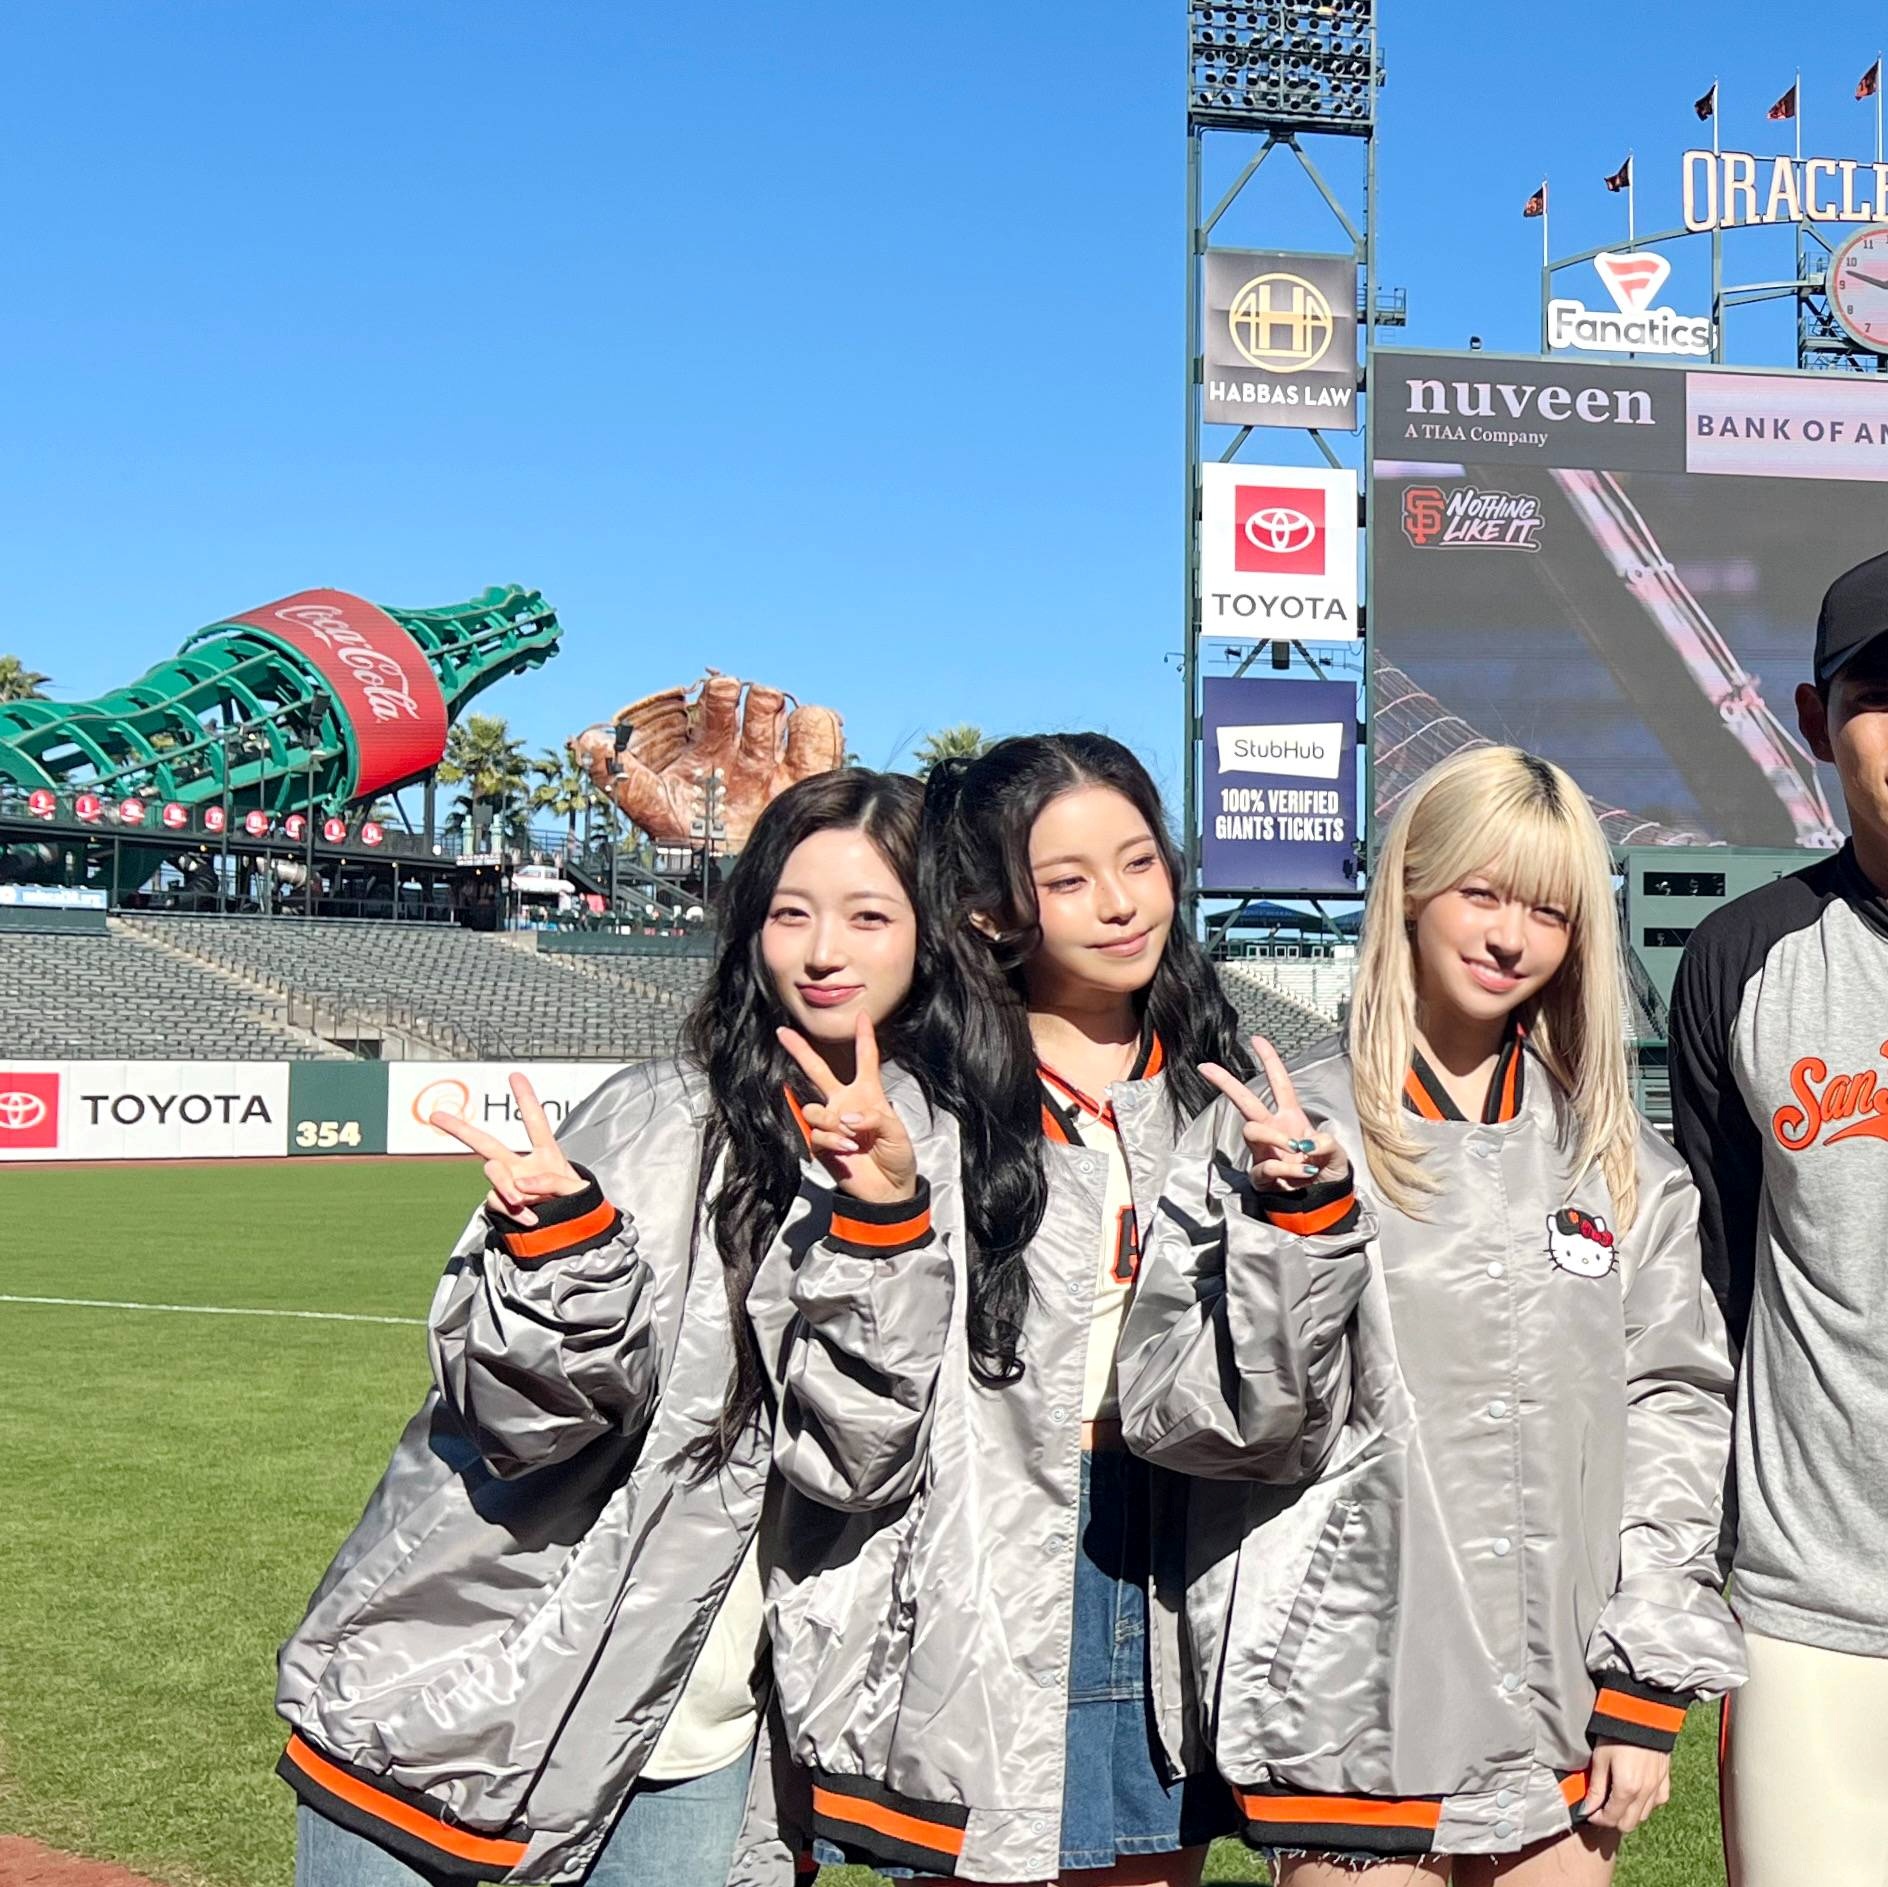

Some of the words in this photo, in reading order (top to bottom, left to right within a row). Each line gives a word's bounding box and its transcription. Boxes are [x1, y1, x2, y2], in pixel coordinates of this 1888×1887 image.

[1556, 308, 1708, 348] Fanatics
[1209, 381, 1299, 405] HABBAS
[1304, 386, 1352, 407] LAW
[1406, 378, 1656, 425] nuveen
[1404, 424, 1419, 438] A
[1422, 424, 1466, 441] TIAA
[1470, 426, 1549, 447] Company
[1697, 414, 1791, 440] BANK
[1803, 419, 1844, 443] OF
[1443, 515, 1506, 542] LIKE
[1505, 518, 1541, 544] IT
[1212, 593, 1348, 621] TOYOTA
[1234, 739, 1325, 760] StubHub
[1221, 788, 1265, 813] 100%
[1267, 789, 1339, 814] VERIFIED
[1216, 816, 1275, 840] GIANTS
[1277, 817, 1345, 841] TICKETS
[81, 1093, 273, 1126] TOYOTA
[1772, 1056, 1877, 1151] San
[295, 1121, 361, 1148] 354
